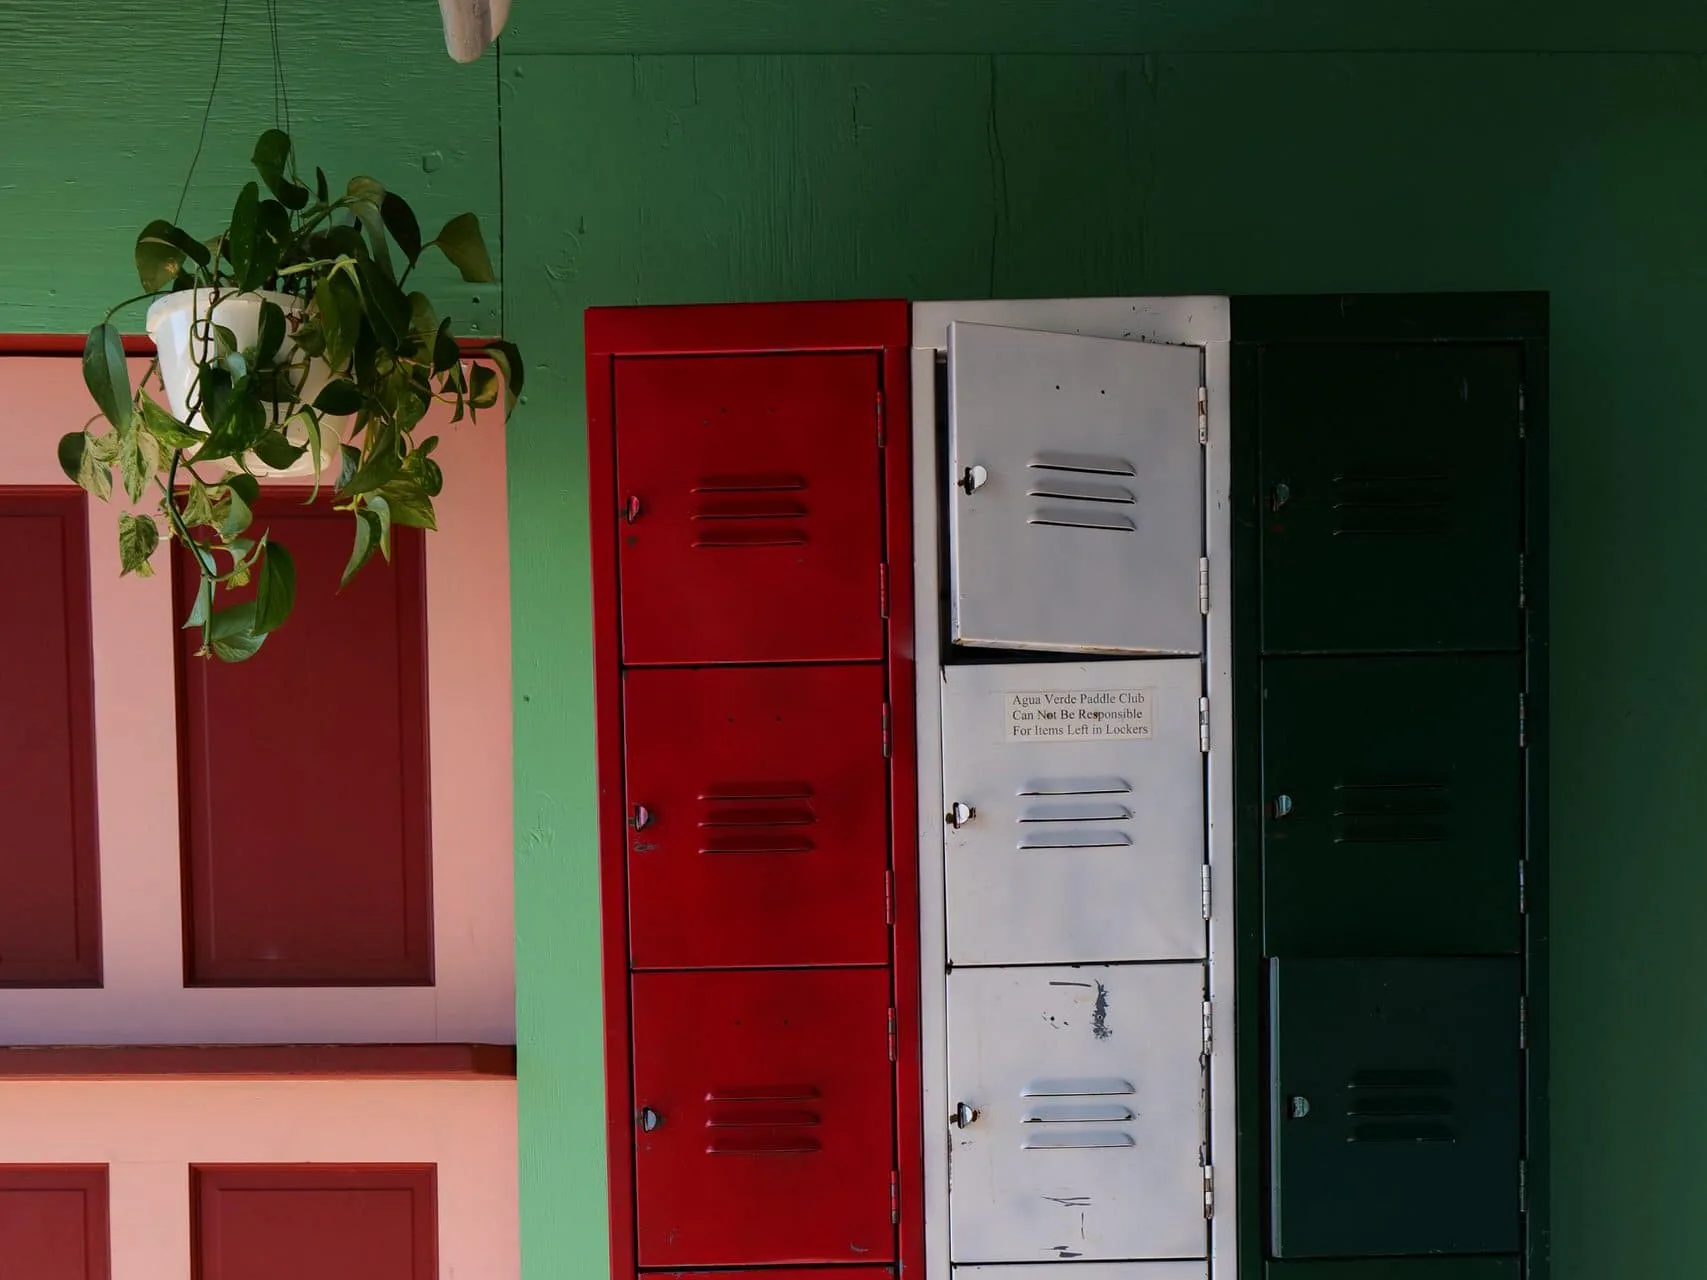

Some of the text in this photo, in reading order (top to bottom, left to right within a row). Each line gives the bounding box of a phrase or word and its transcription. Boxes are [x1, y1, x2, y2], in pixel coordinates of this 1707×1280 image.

[1012, 692, 1145, 708] Agua Verde Paddle Club
[1012, 709, 1143, 722] Can Not Be Responsible
[1013, 724, 1149, 736] For Items Left in Lockers
